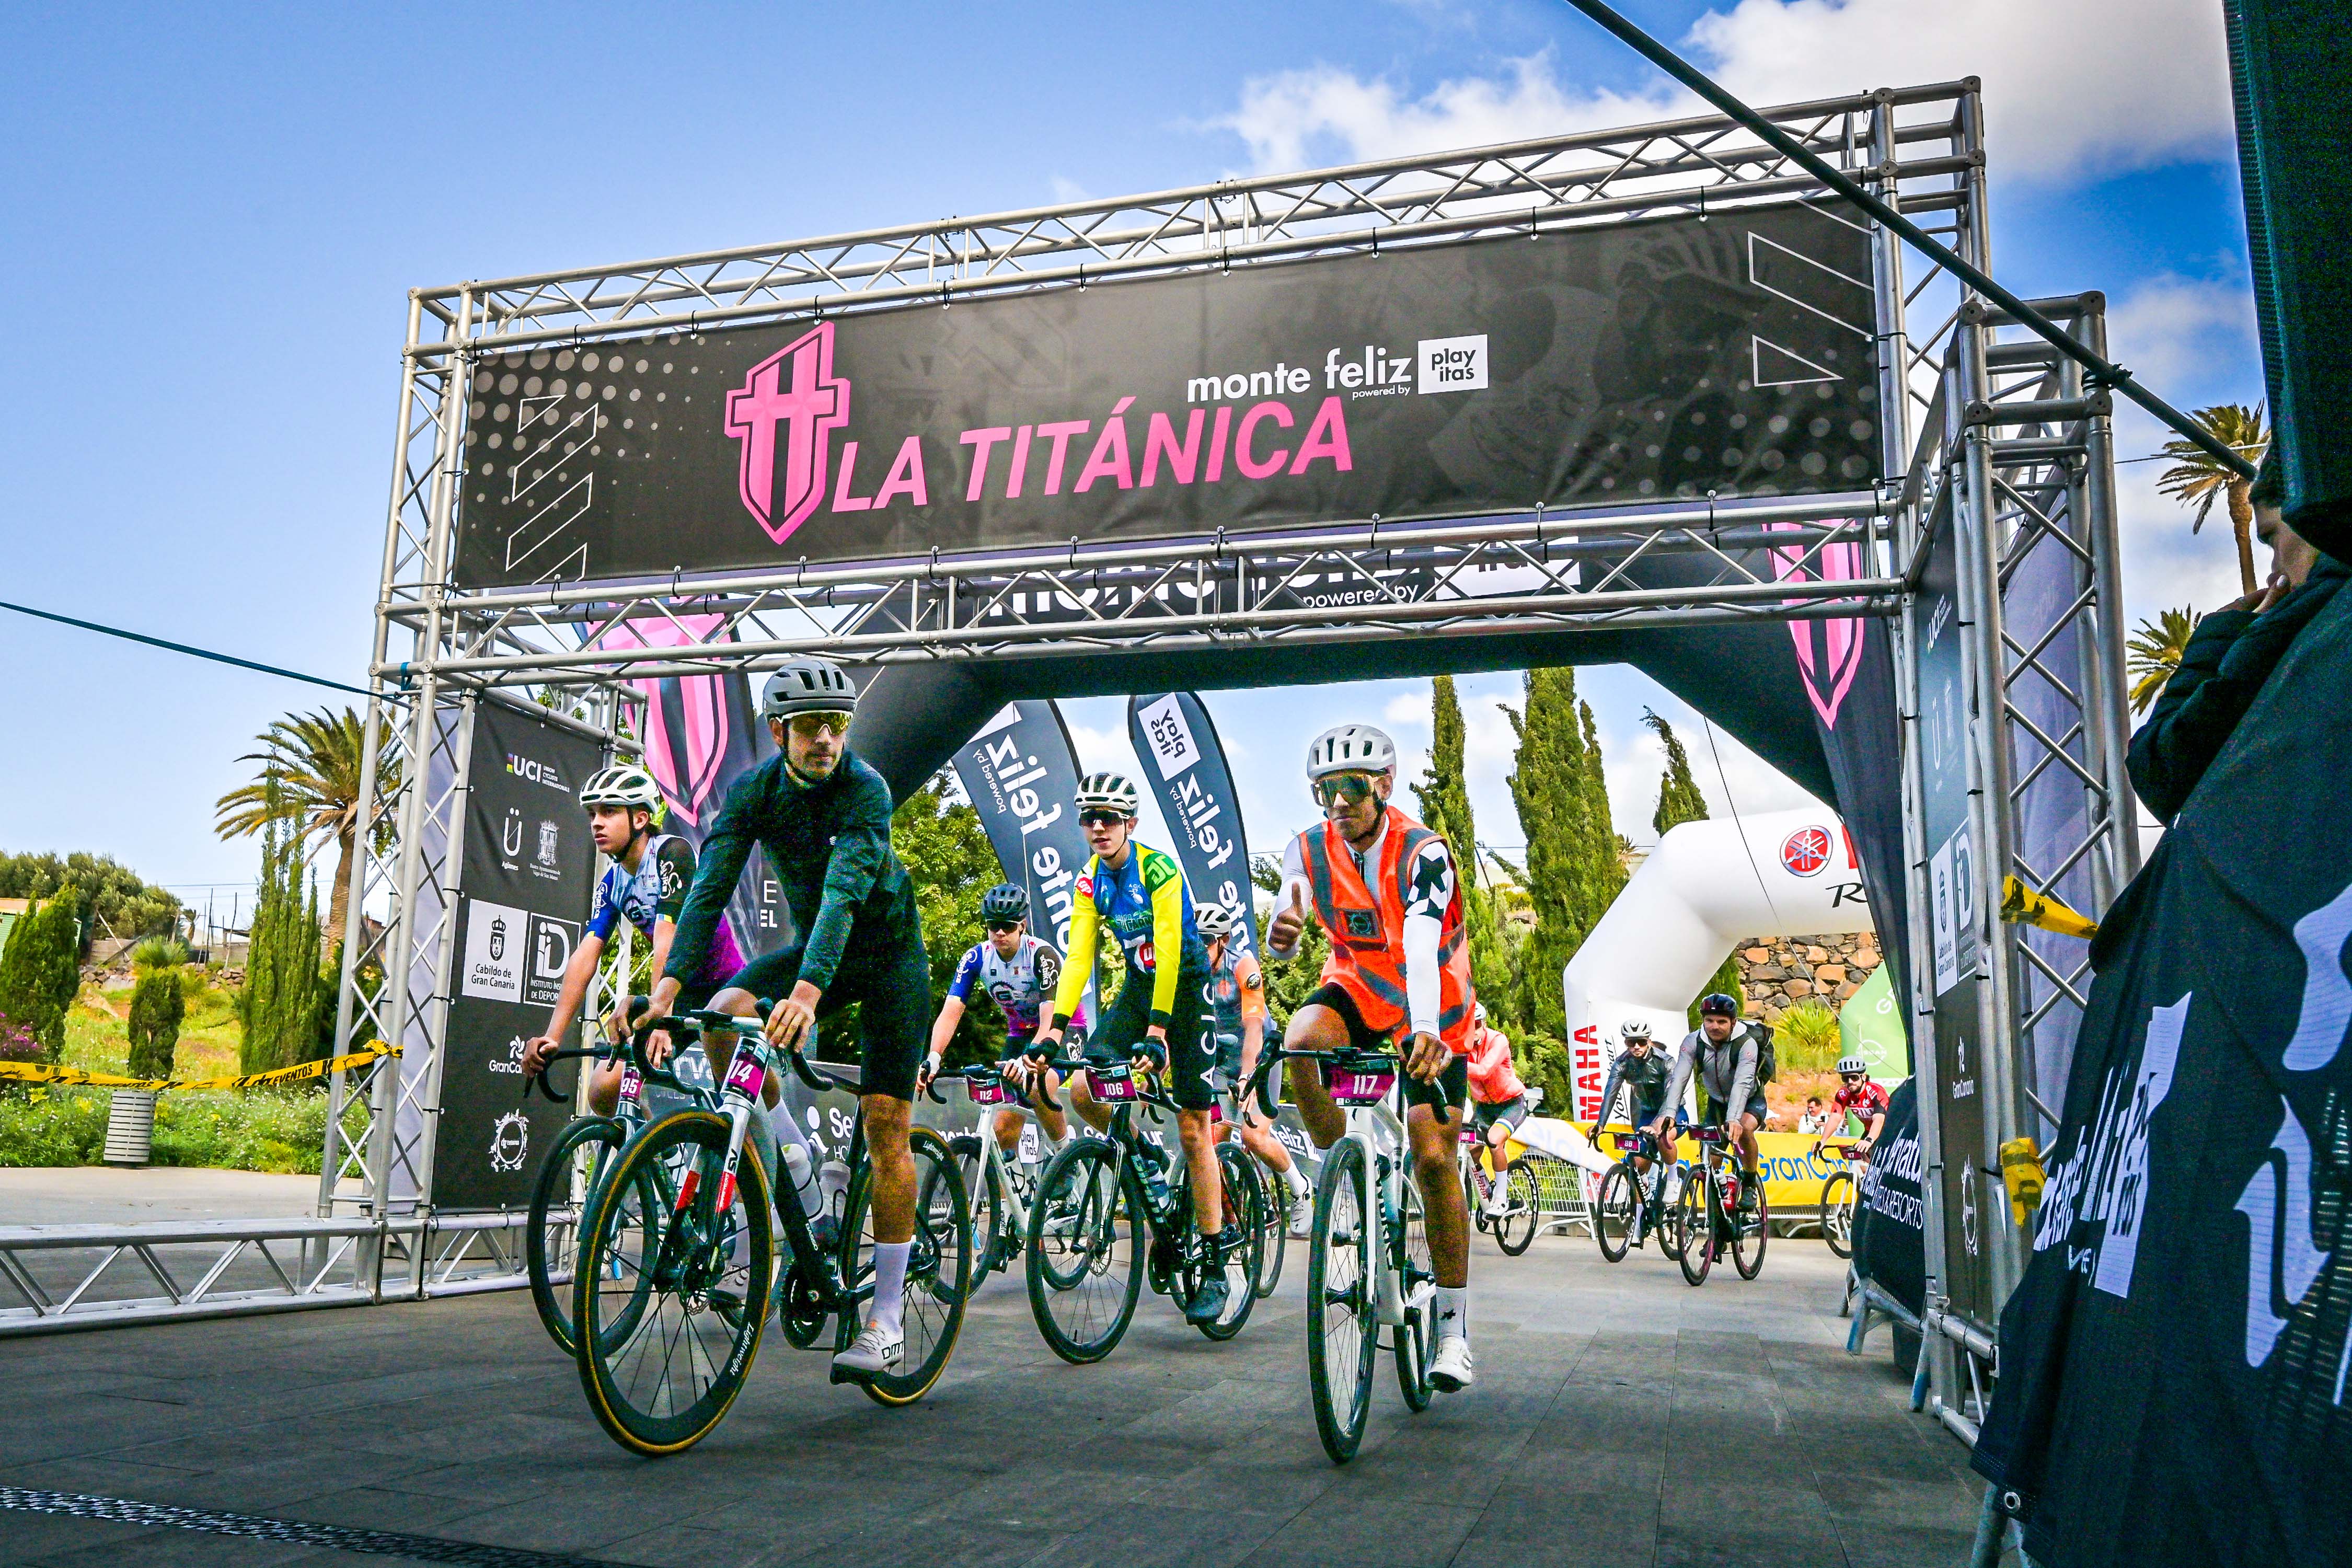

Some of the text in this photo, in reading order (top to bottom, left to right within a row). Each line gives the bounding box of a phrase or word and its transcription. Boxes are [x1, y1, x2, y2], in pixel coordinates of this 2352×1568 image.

[1431, 348, 1477, 367] play
[1187, 345, 1412, 402] monte feliz
[1439, 366, 1475, 382] itas
[1352, 385, 1411, 400] powered by
[832, 396, 1353, 513] LA TITÁNICA
[1303, 579, 1419, 608] powered by
[514, 755, 541, 782] UCI
[475, 963, 512, 978] Cabildo de
[471, 974, 515, 990] Gran Canaria
[273, 1064, 313, 1085] EVENTOS
[1103, 1082, 1124, 1096] 106
[1353, 1075, 1378, 1094] 117
[979, 1089, 993, 1100] 112
[1021, 1131, 1034, 1146] play
[729, 1321, 755, 1377] Lightweight
